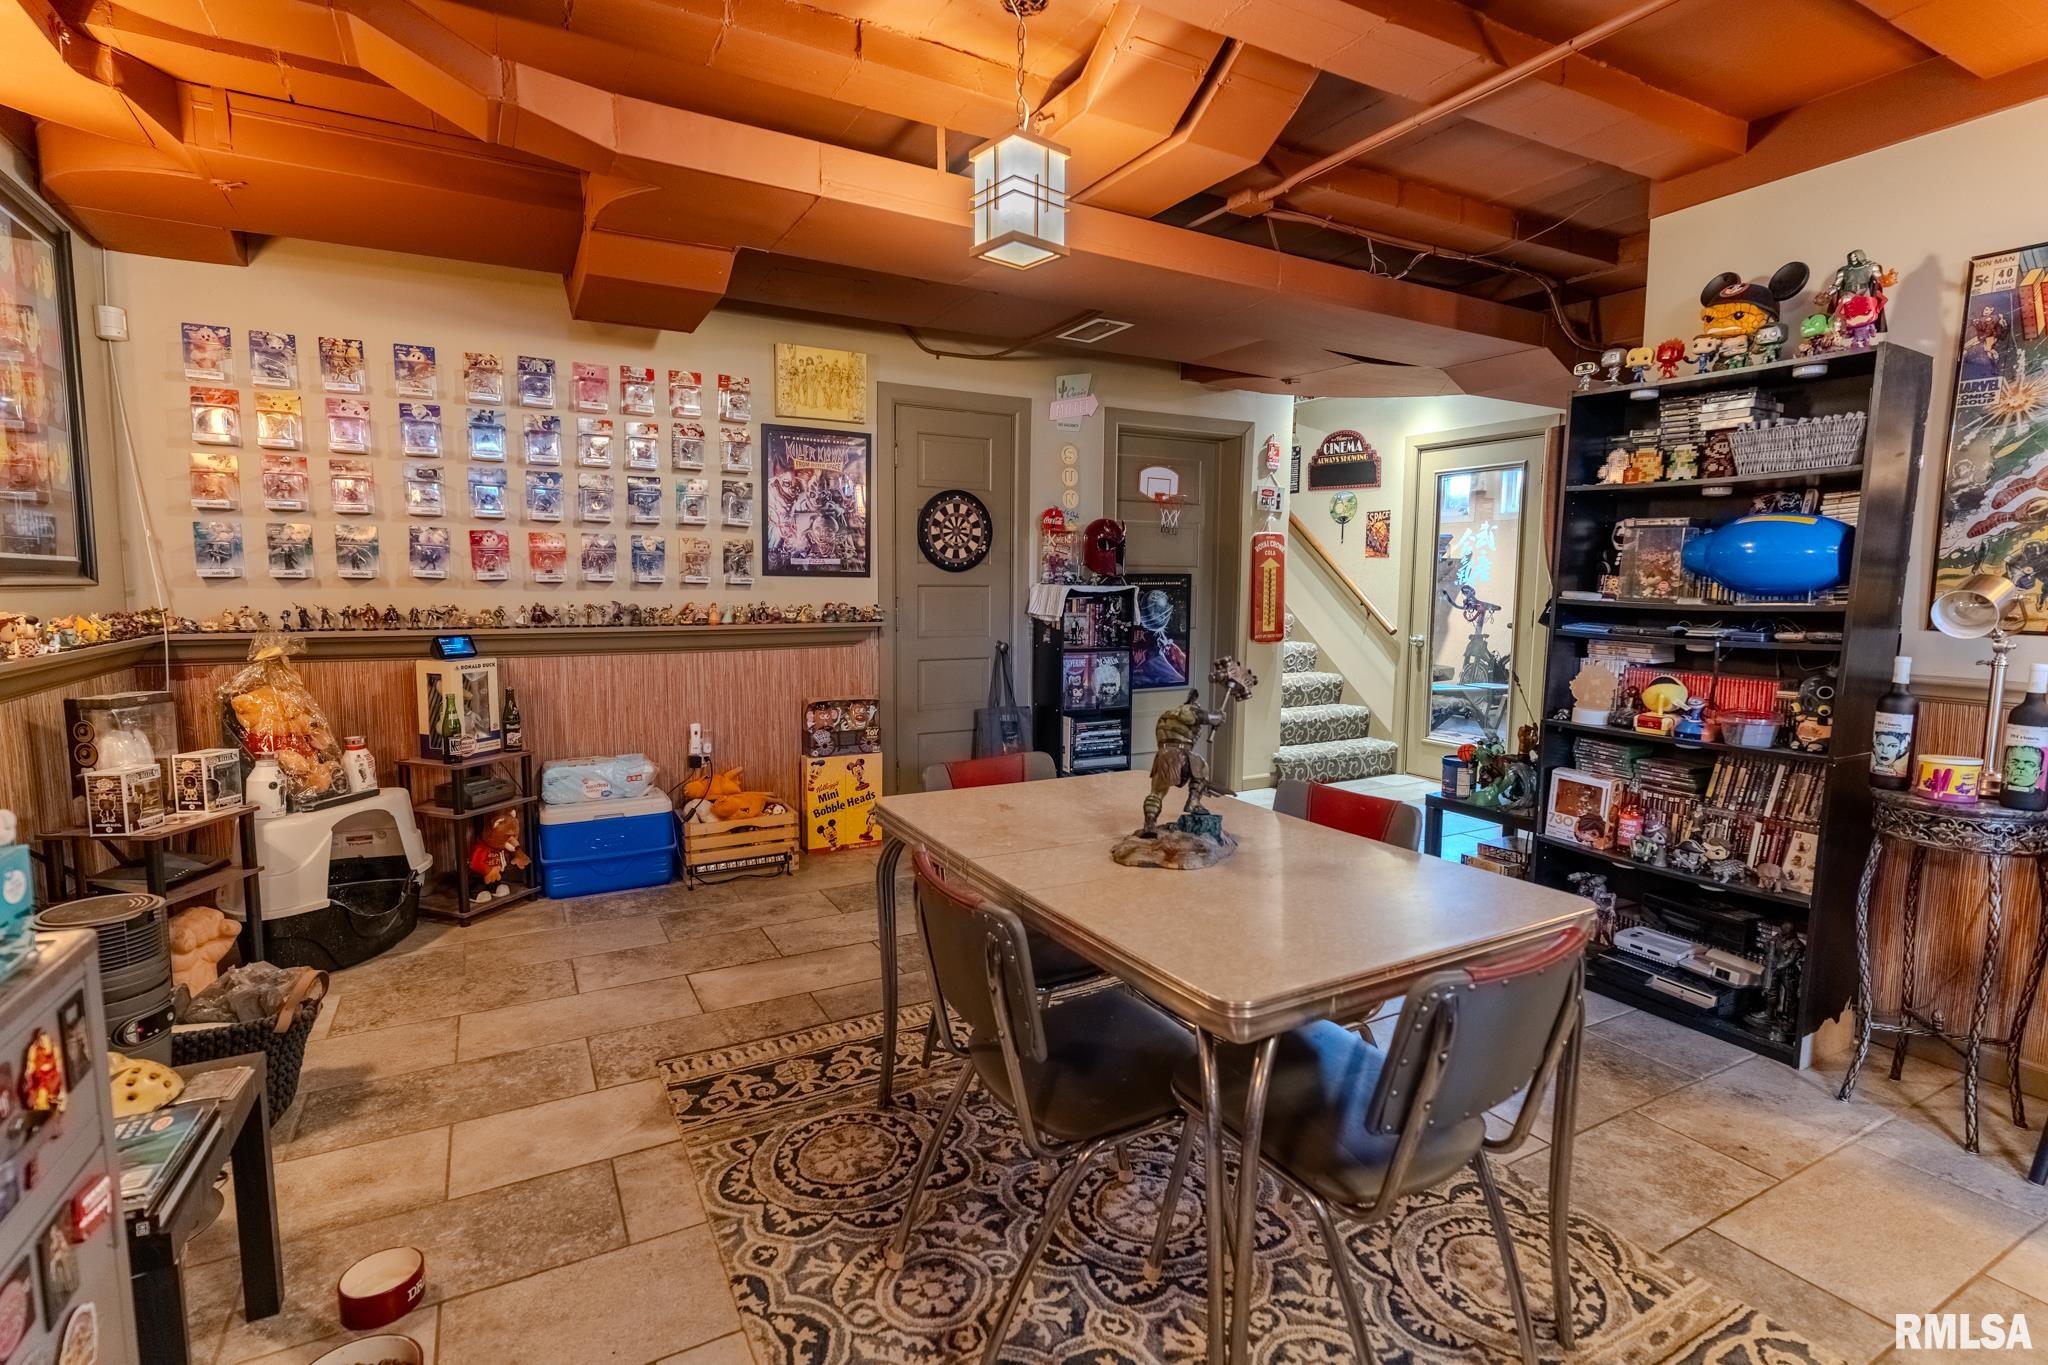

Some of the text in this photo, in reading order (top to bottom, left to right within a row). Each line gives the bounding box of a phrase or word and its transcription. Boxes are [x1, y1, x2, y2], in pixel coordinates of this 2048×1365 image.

[1998, 268, 2013, 278] 40
[1995, 278, 2014, 286] AUG
[1957, 398, 1996, 406] ROUP
[1958, 391, 1997, 401] OMICS
[785, 440, 817, 463] KILLER
[1323, 439, 1363, 455] CINEMA
[1317, 453, 1369, 464] ALWAYS SHOWING
[1369, 511, 1390, 526] SPACE
[865, 728, 880, 736] TOY
[817, 788, 840, 804] Mini
[813, 791, 875, 818] Bobble Heads
[1548, 811, 1574, 827] 730
